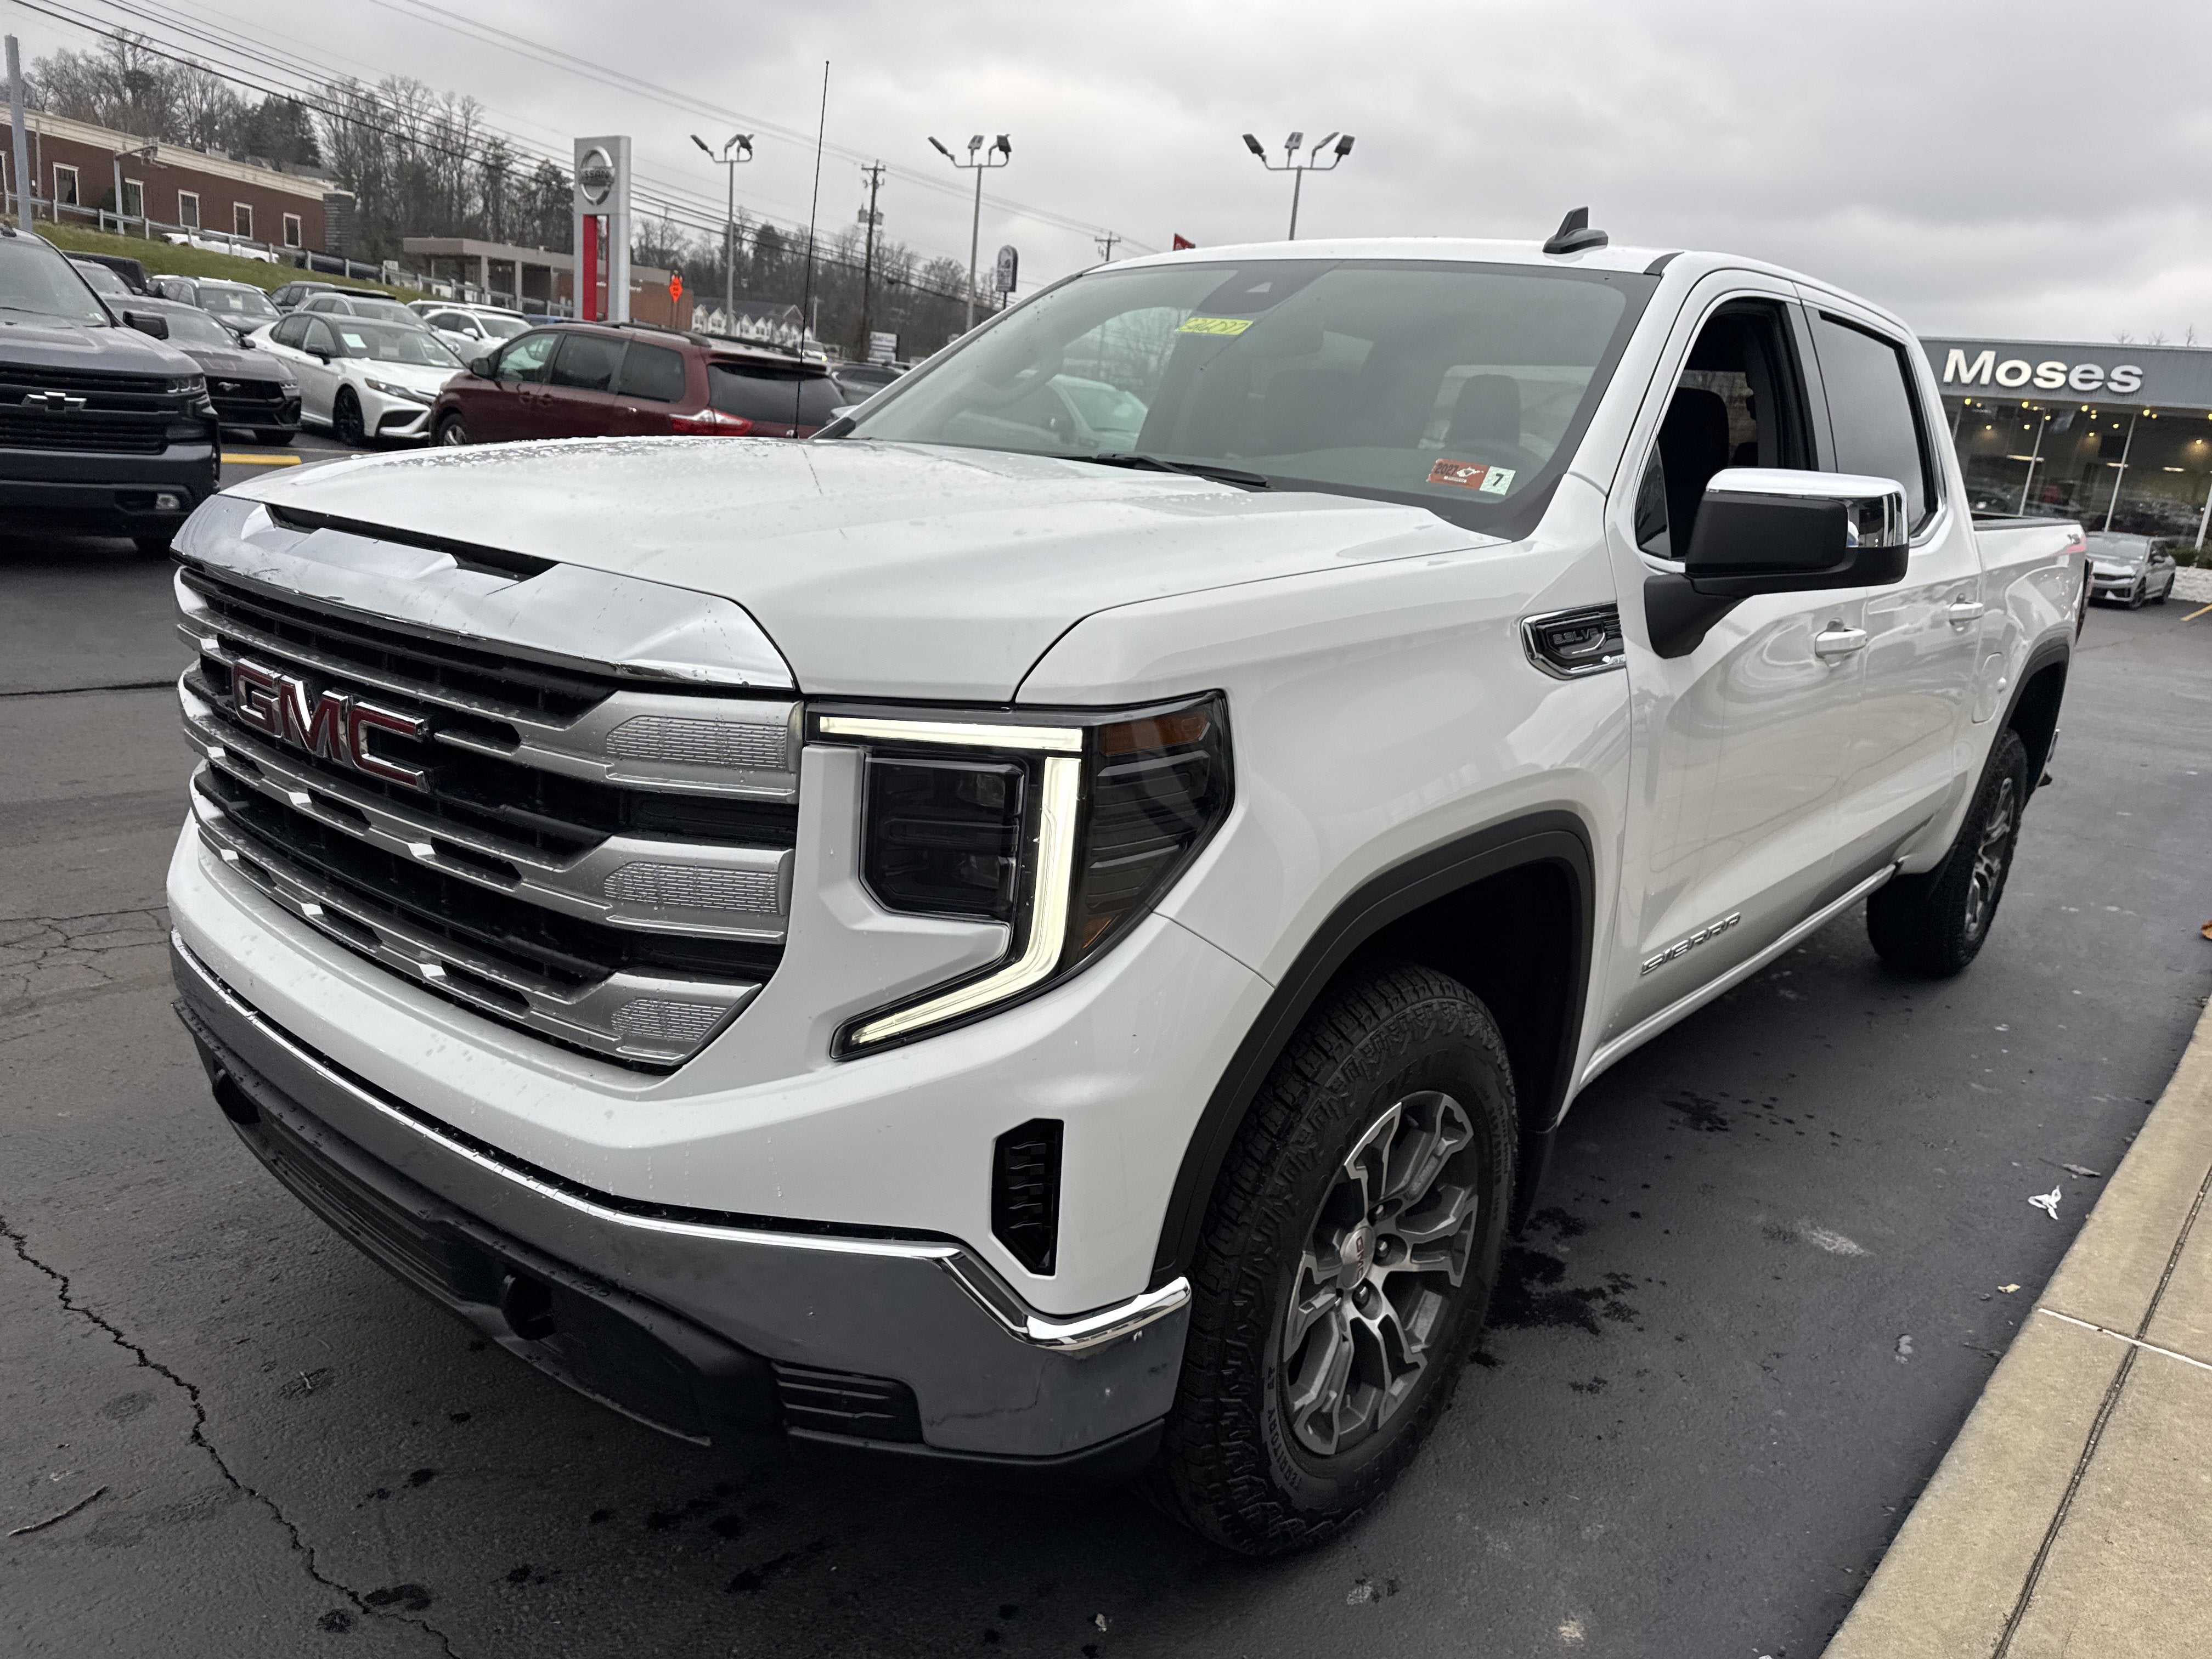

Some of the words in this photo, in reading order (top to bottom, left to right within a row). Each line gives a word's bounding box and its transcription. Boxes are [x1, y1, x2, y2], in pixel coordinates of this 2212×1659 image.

[1943, 348, 2143, 393] Moses
[1435, 462, 1459, 476] 2027
[1492, 473, 1504, 487] 7
[233, 658, 430, 794] GMC
[1641, 912, 1740, 975] SIERRA
[1355, 1235, 1364, 1282] GMC
[1267, 1409, 1302, 1492] TERRITORY
